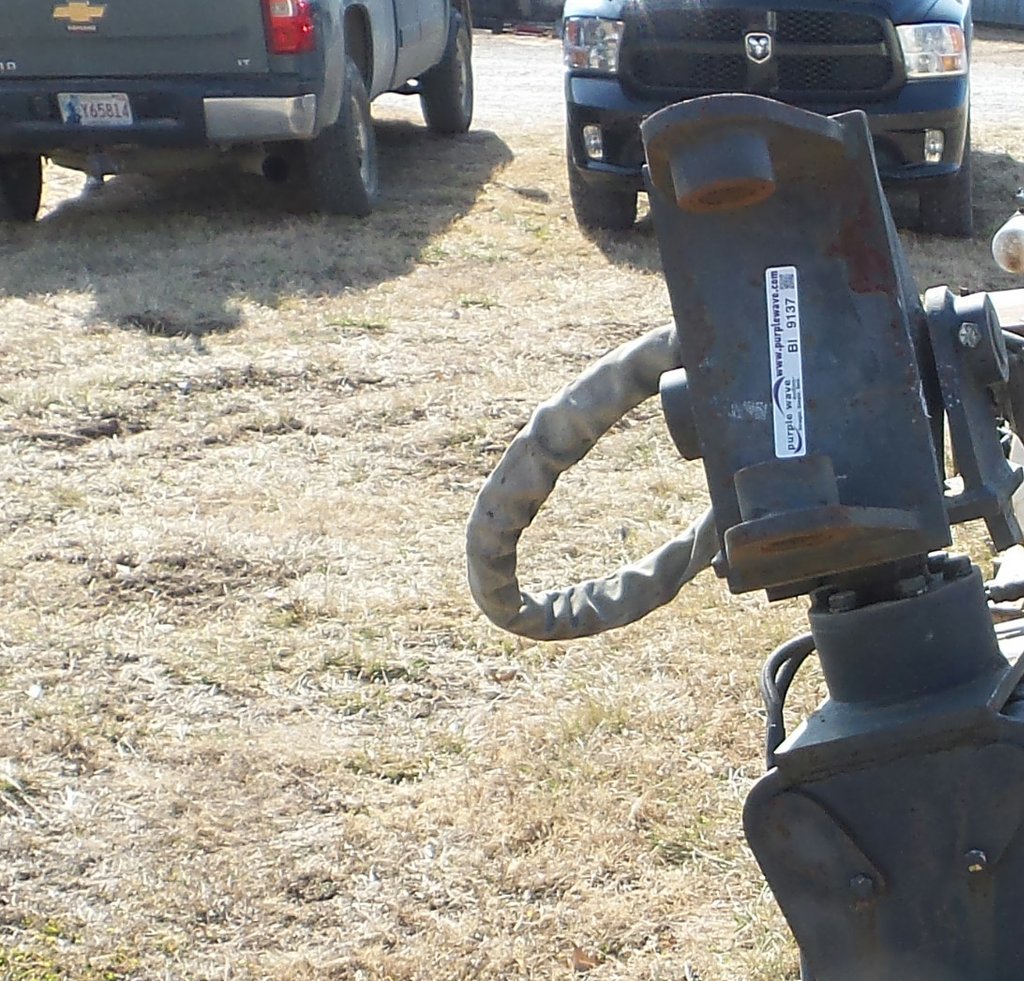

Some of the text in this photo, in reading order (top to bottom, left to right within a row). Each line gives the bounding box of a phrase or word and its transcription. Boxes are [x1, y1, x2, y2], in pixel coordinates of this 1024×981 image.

[770, 270, 784, 377] www.purplewave.com
[784, 297, 797, 329] 9137
[784, 380, 796, 451] purple wave
